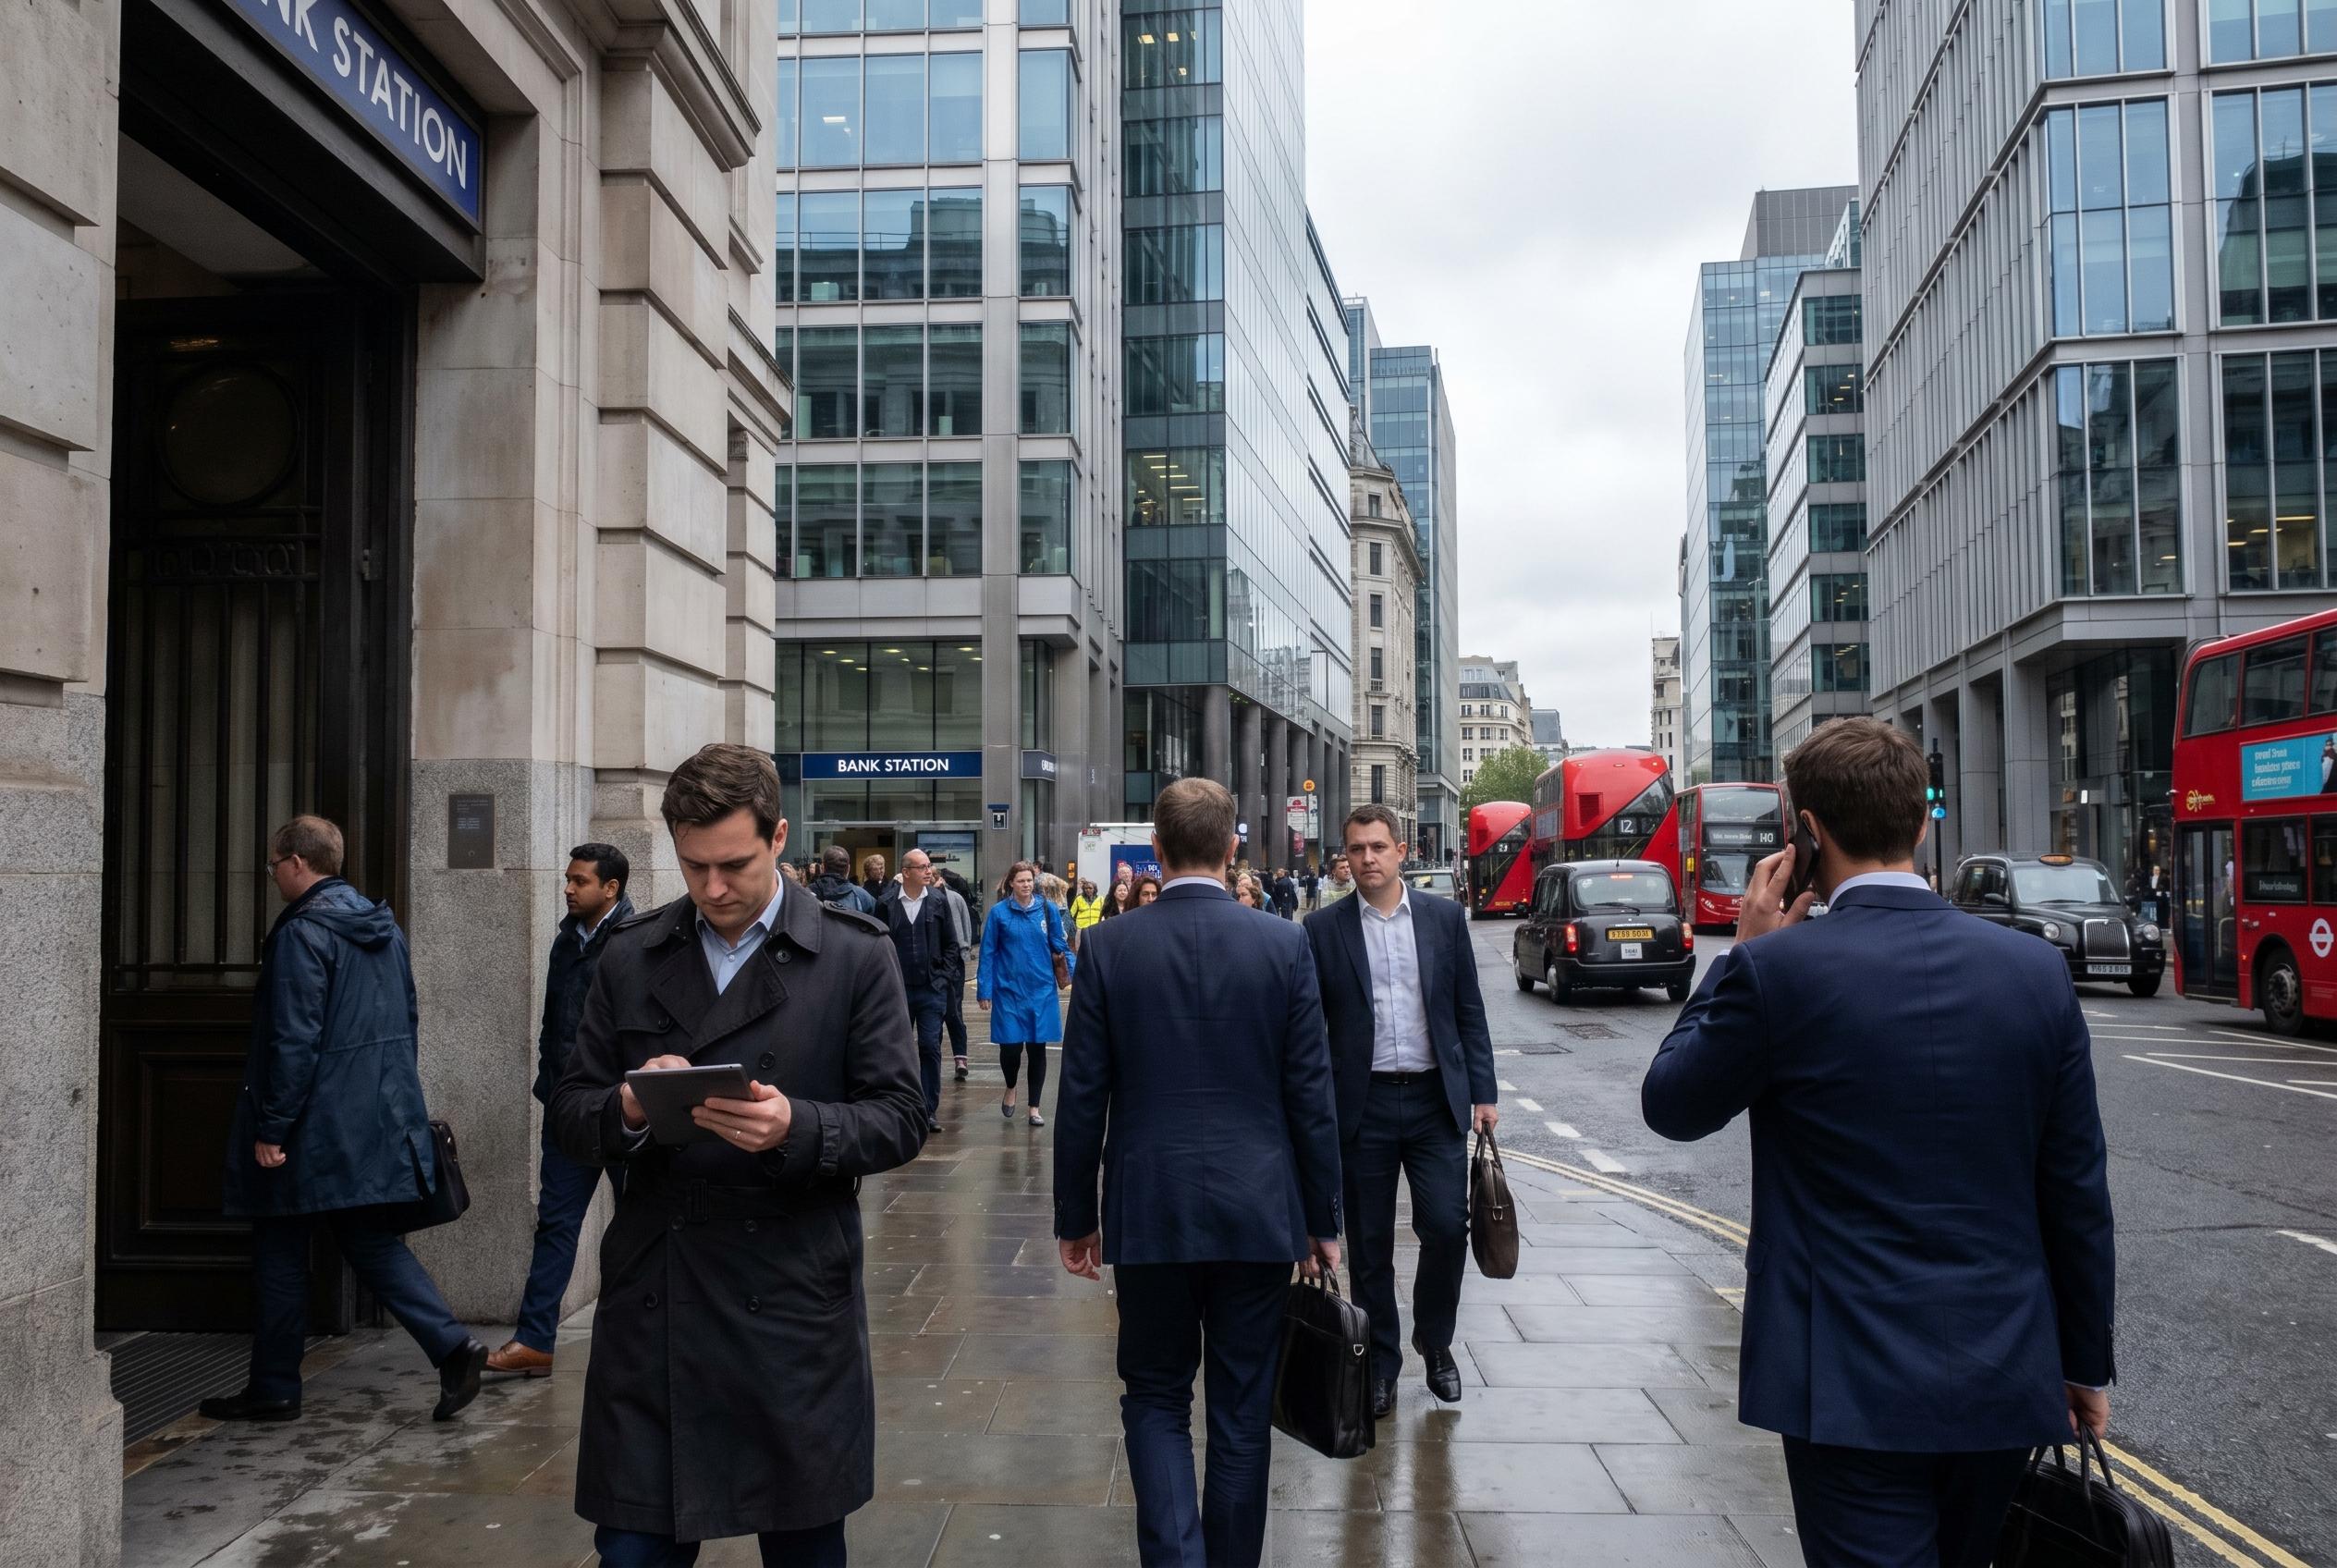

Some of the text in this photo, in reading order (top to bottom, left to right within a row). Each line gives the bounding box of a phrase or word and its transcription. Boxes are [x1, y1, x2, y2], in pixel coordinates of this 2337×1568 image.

[333, 16, 467, 190] STATION
[838, 758, 949, 773] BANK STATION
[1621, 819, 1633, 833] 12
